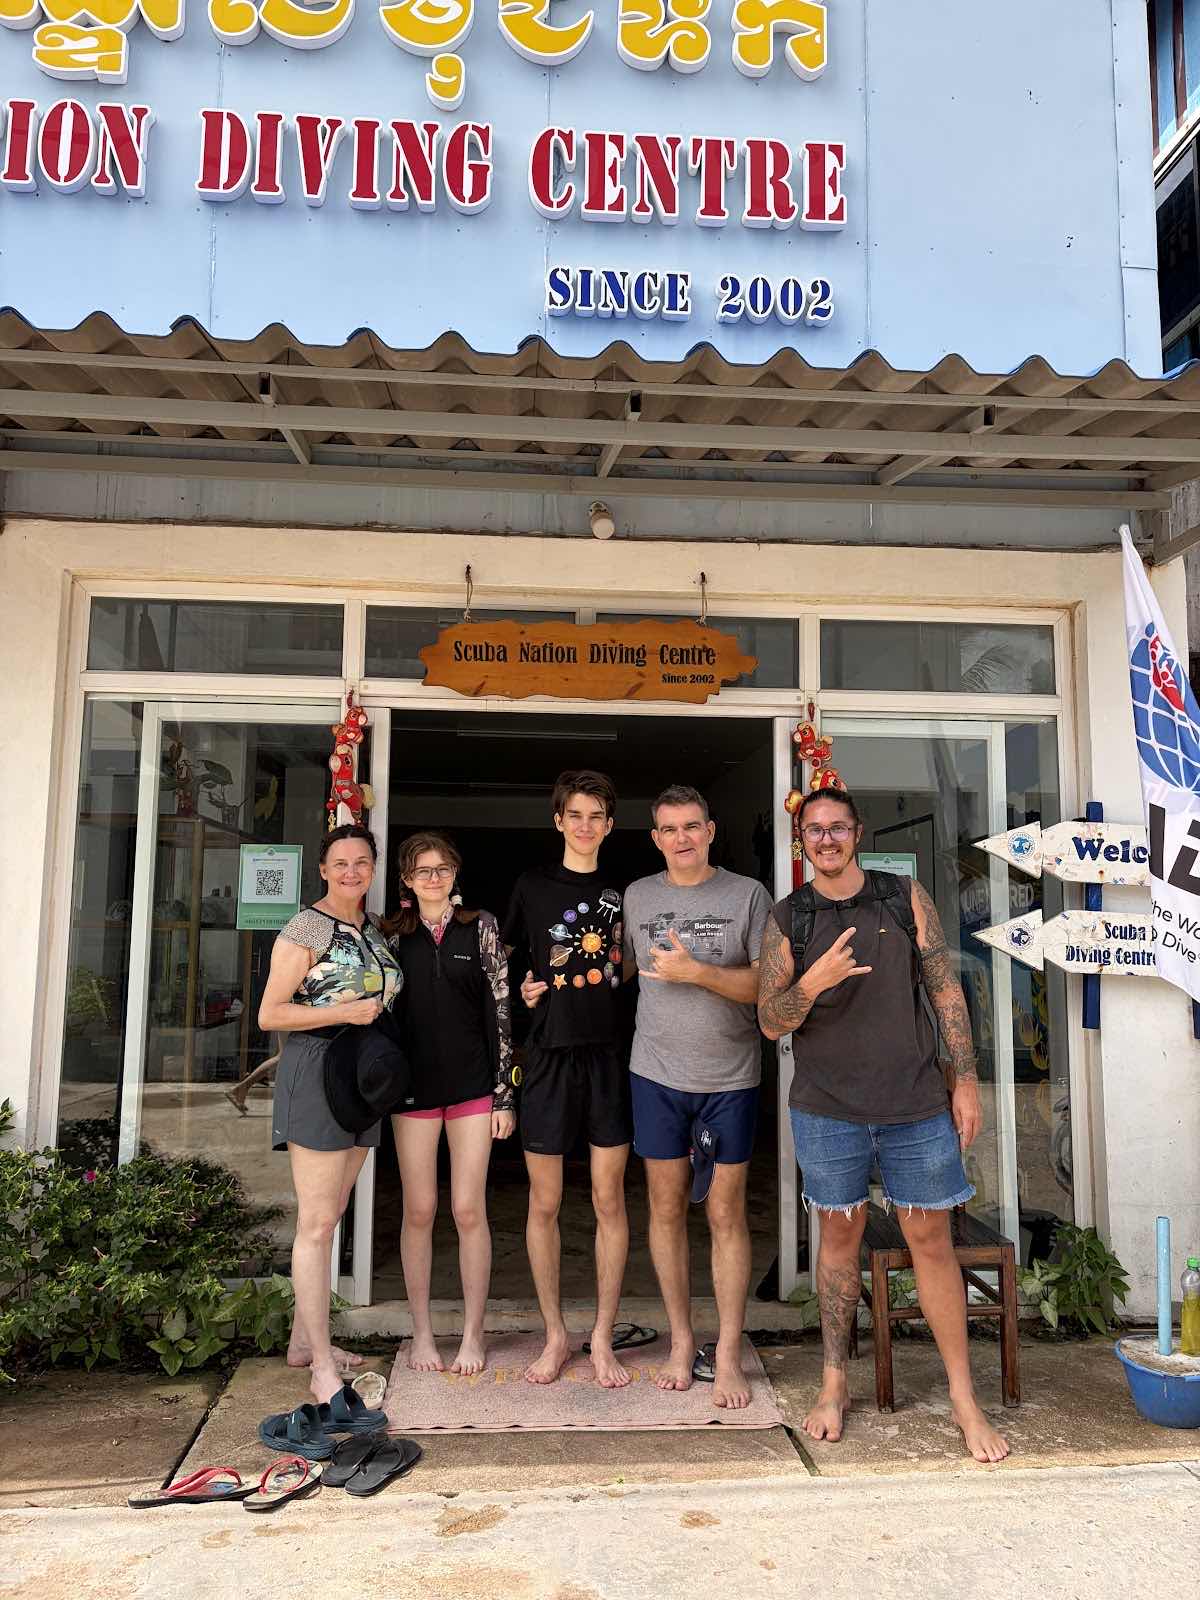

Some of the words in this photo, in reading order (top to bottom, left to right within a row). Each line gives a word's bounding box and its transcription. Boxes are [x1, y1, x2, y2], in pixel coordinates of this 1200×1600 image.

[2, 100, 149, 187] ION
[198, 110, 493, 205] DIVING
[531, 128, 846, 222] CENTRE
[548, 266, 690, 313] SINCE
[719, 275, 832, 318] 2002
[453, 640, 508, 663] Scuba
[519, 642, 578, 665] Nation
[589, 643, 648, 667] Diving
[659, 643, 717, 666] Centre
[661, 672, 688, 684] Since
[689, 673, 715, 684] 2002
[1071, 835, 1150, 864] Welc
[1152, 900, 1173, 922] he
[694, 922, 723, 930] Barbour
[1104, 922, 1147, 941] Scuba
[1065, 945, 1111, 966] Diving
